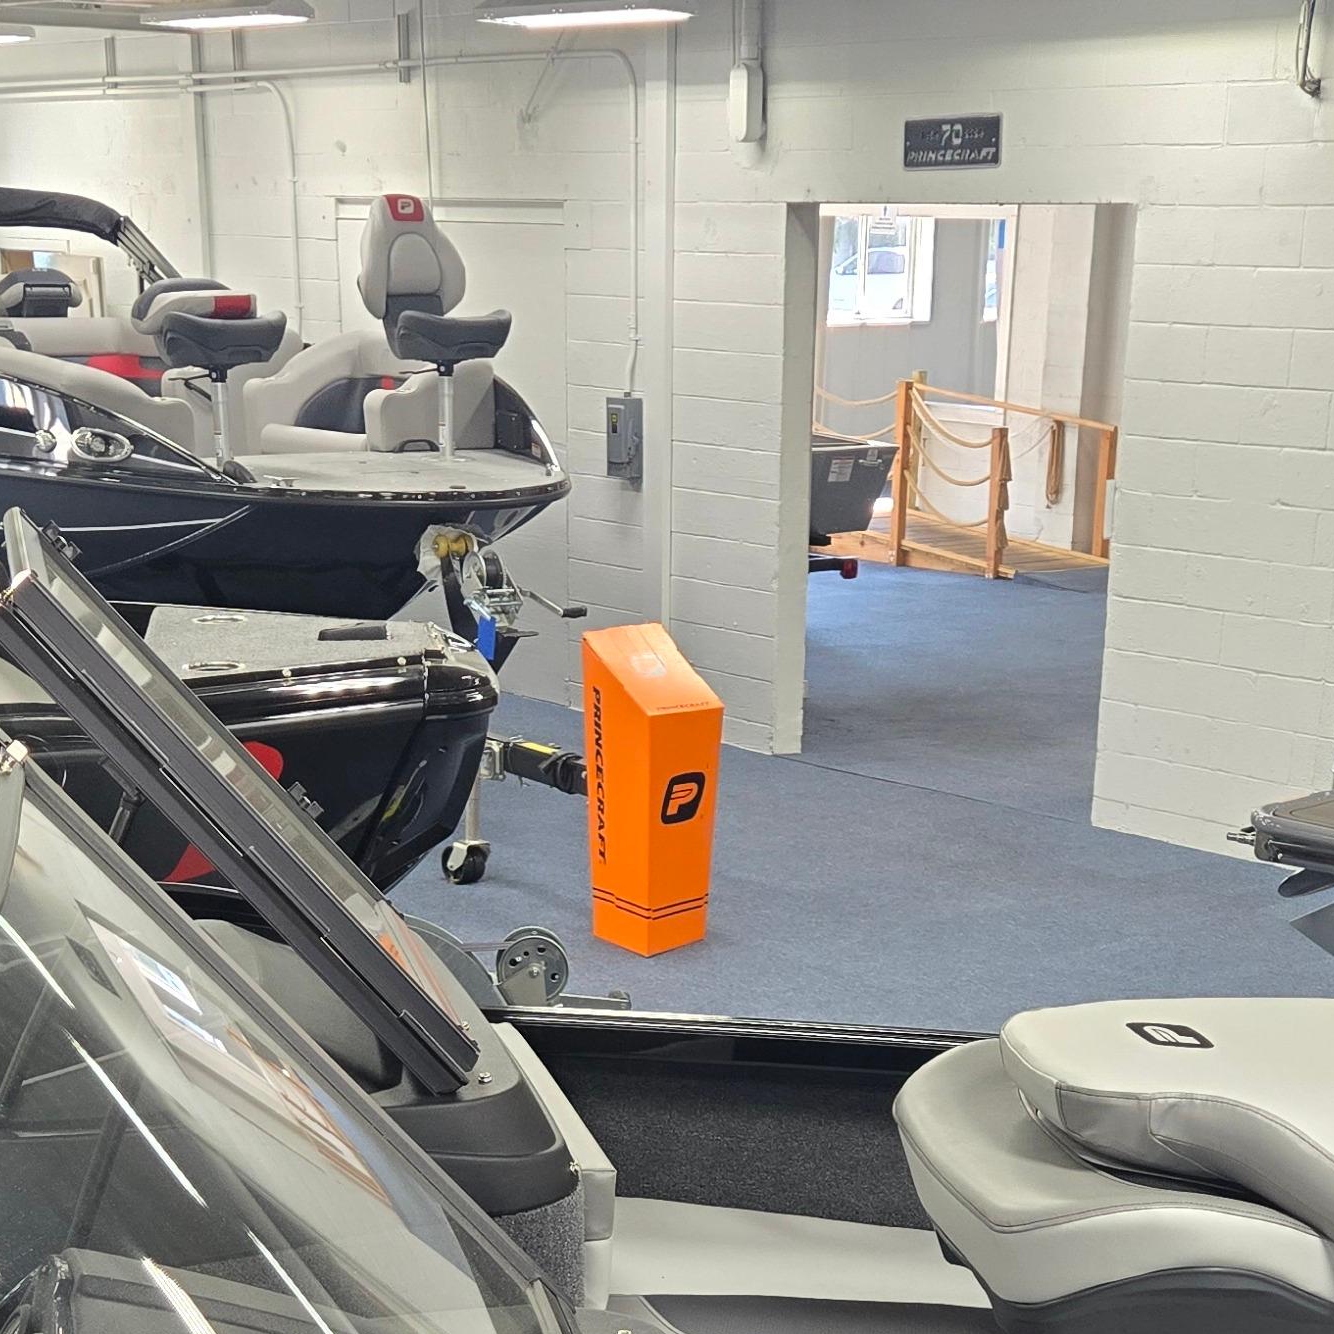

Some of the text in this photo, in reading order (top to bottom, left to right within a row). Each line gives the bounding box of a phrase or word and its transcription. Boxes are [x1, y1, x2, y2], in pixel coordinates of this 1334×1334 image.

[941, 123, 963, 146] 70
[907, 147, 997, 161] PRINCECRAFT
[592, 685, 607, 865] PRINCECRAFT
